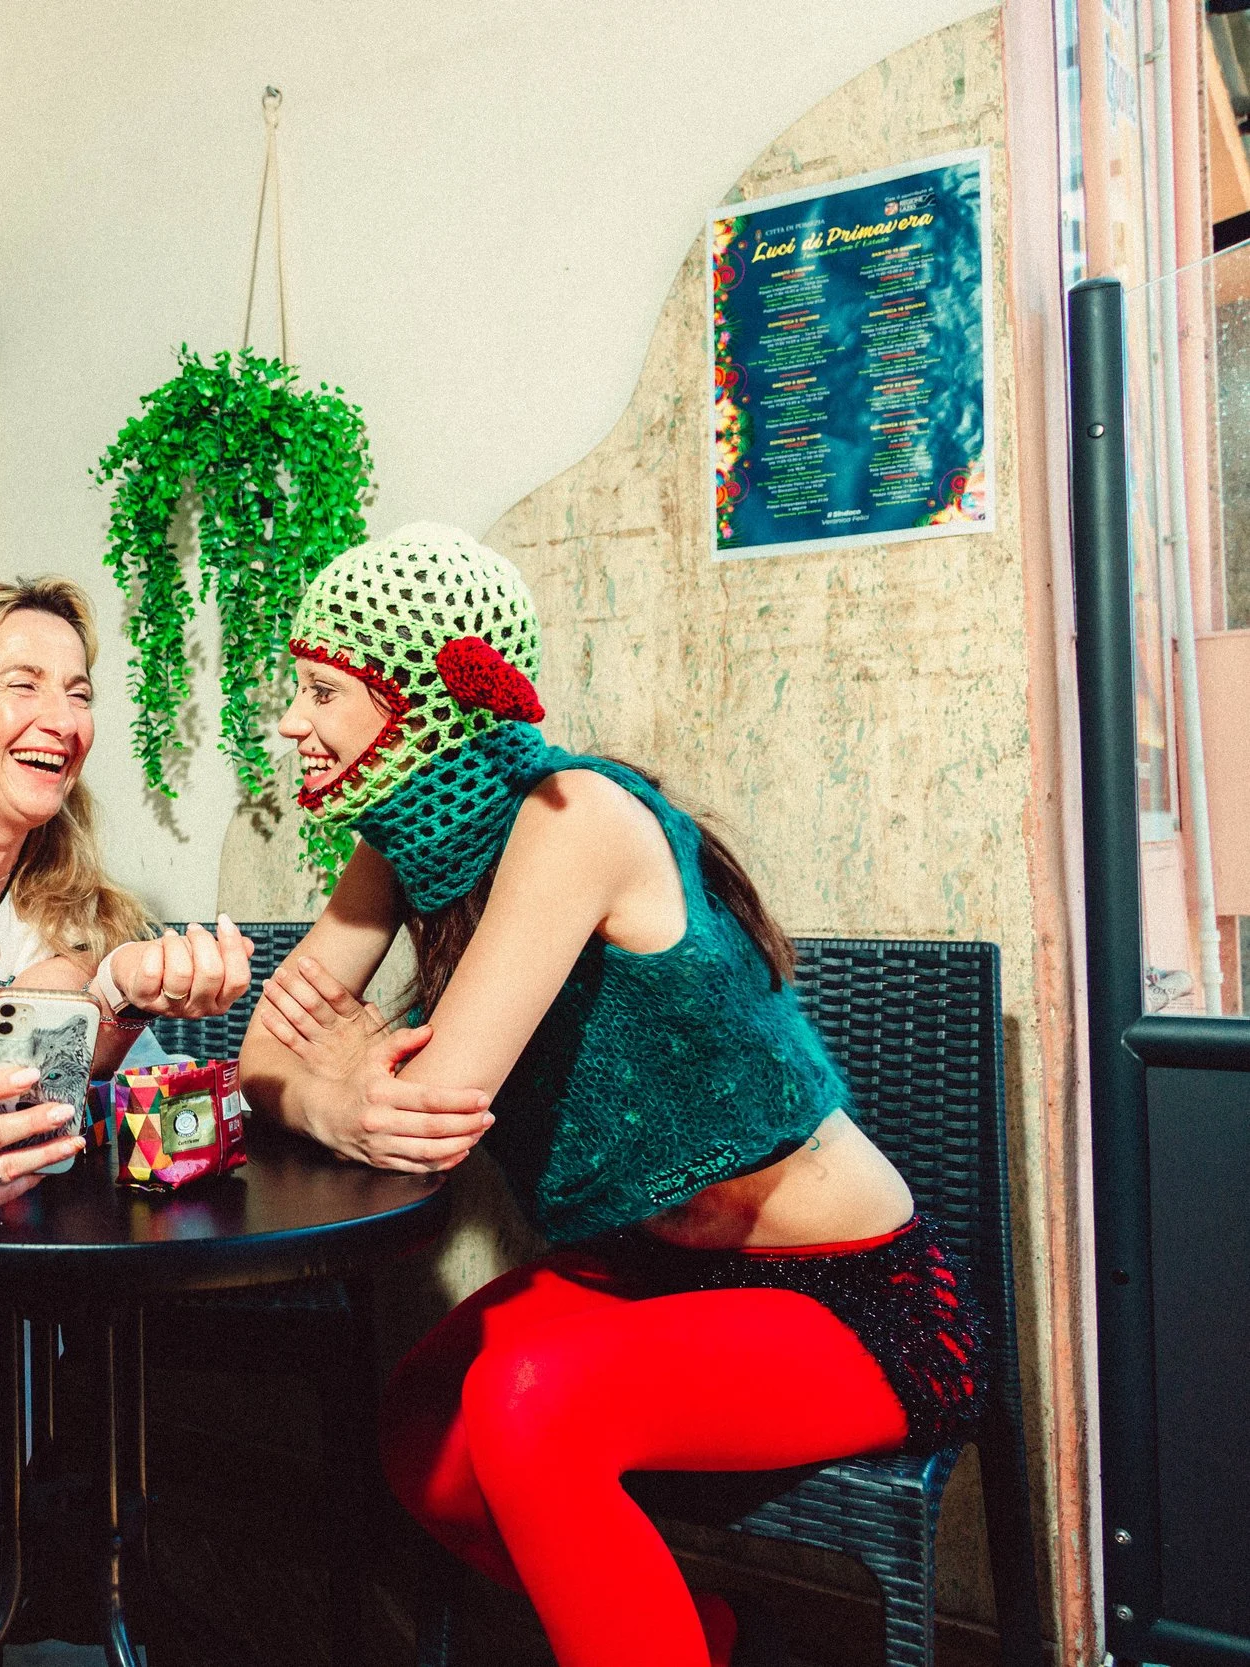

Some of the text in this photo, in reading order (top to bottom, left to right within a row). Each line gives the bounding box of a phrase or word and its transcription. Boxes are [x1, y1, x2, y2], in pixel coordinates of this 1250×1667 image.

[752, 212, 934, 263] Luci di Primavera
